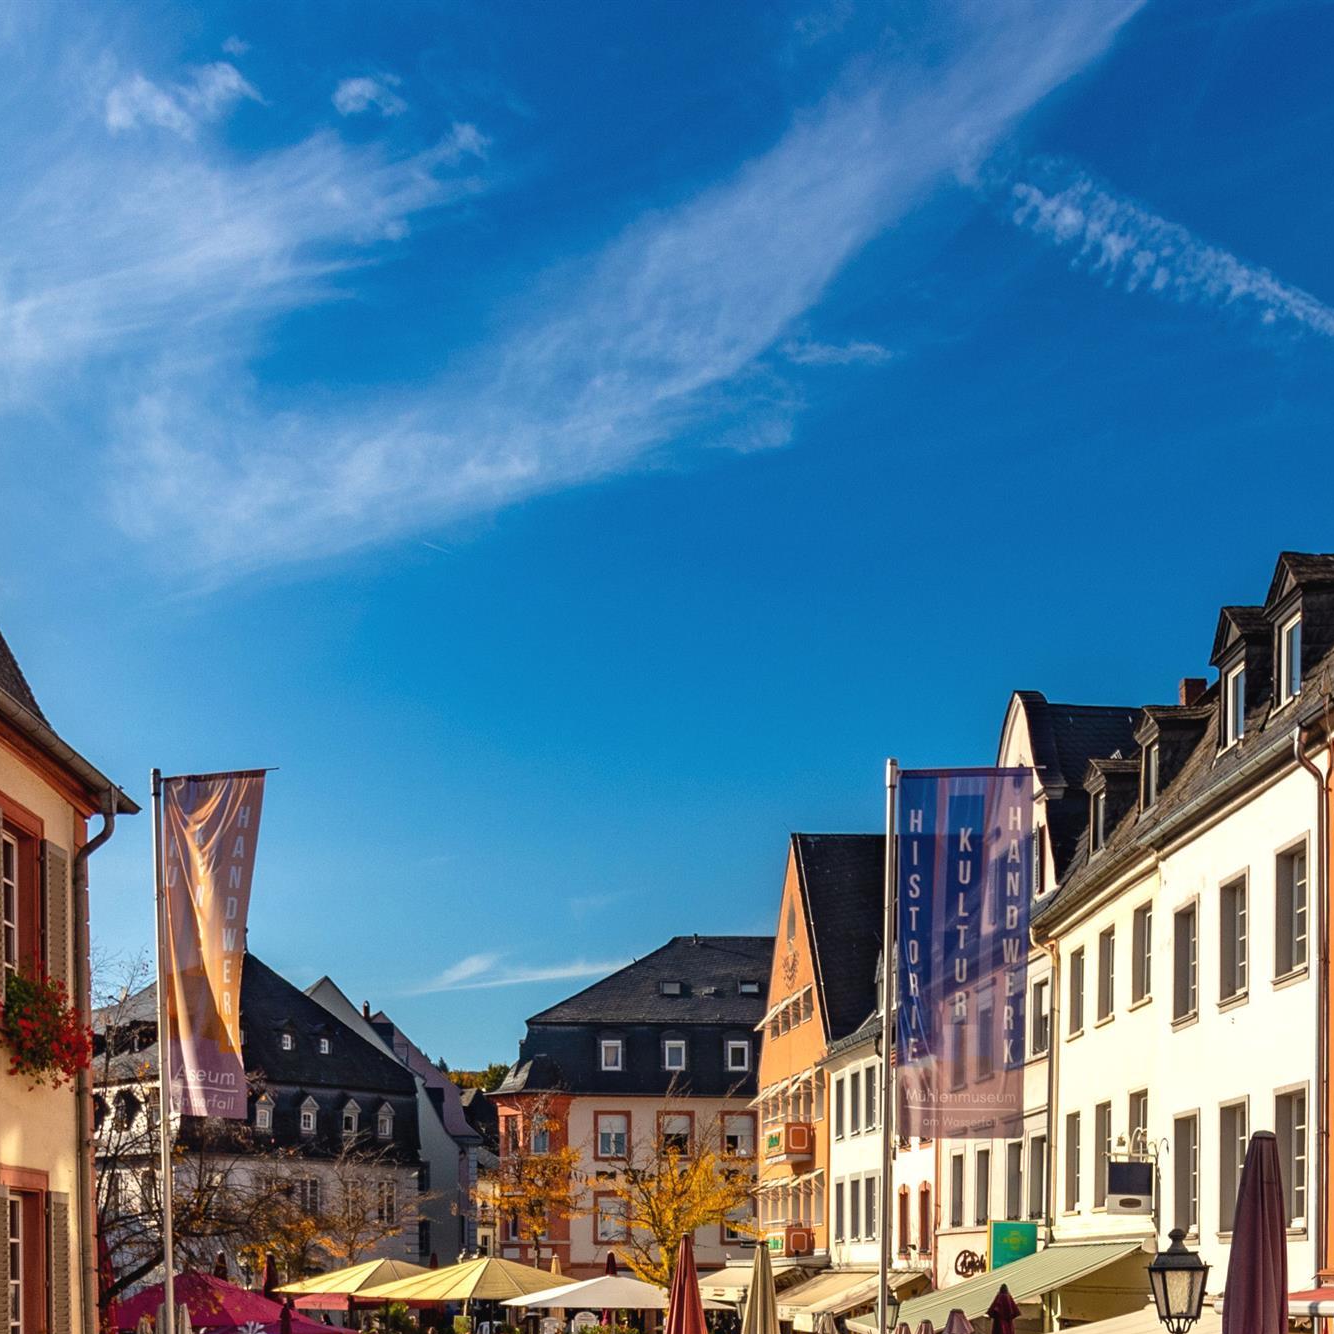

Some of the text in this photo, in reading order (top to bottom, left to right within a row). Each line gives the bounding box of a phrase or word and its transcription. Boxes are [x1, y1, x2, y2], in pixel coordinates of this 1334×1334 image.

[908, 809, 923, 1063] HISTORIE
[954, 827, 973, 1018] KULTUR
[1002, 806, 1022, 1065] HANDWERK
[905, 1088, 1016, 1105] Mühlenmuseum
[922, 1115, 999, 1127] am Wasserfall
